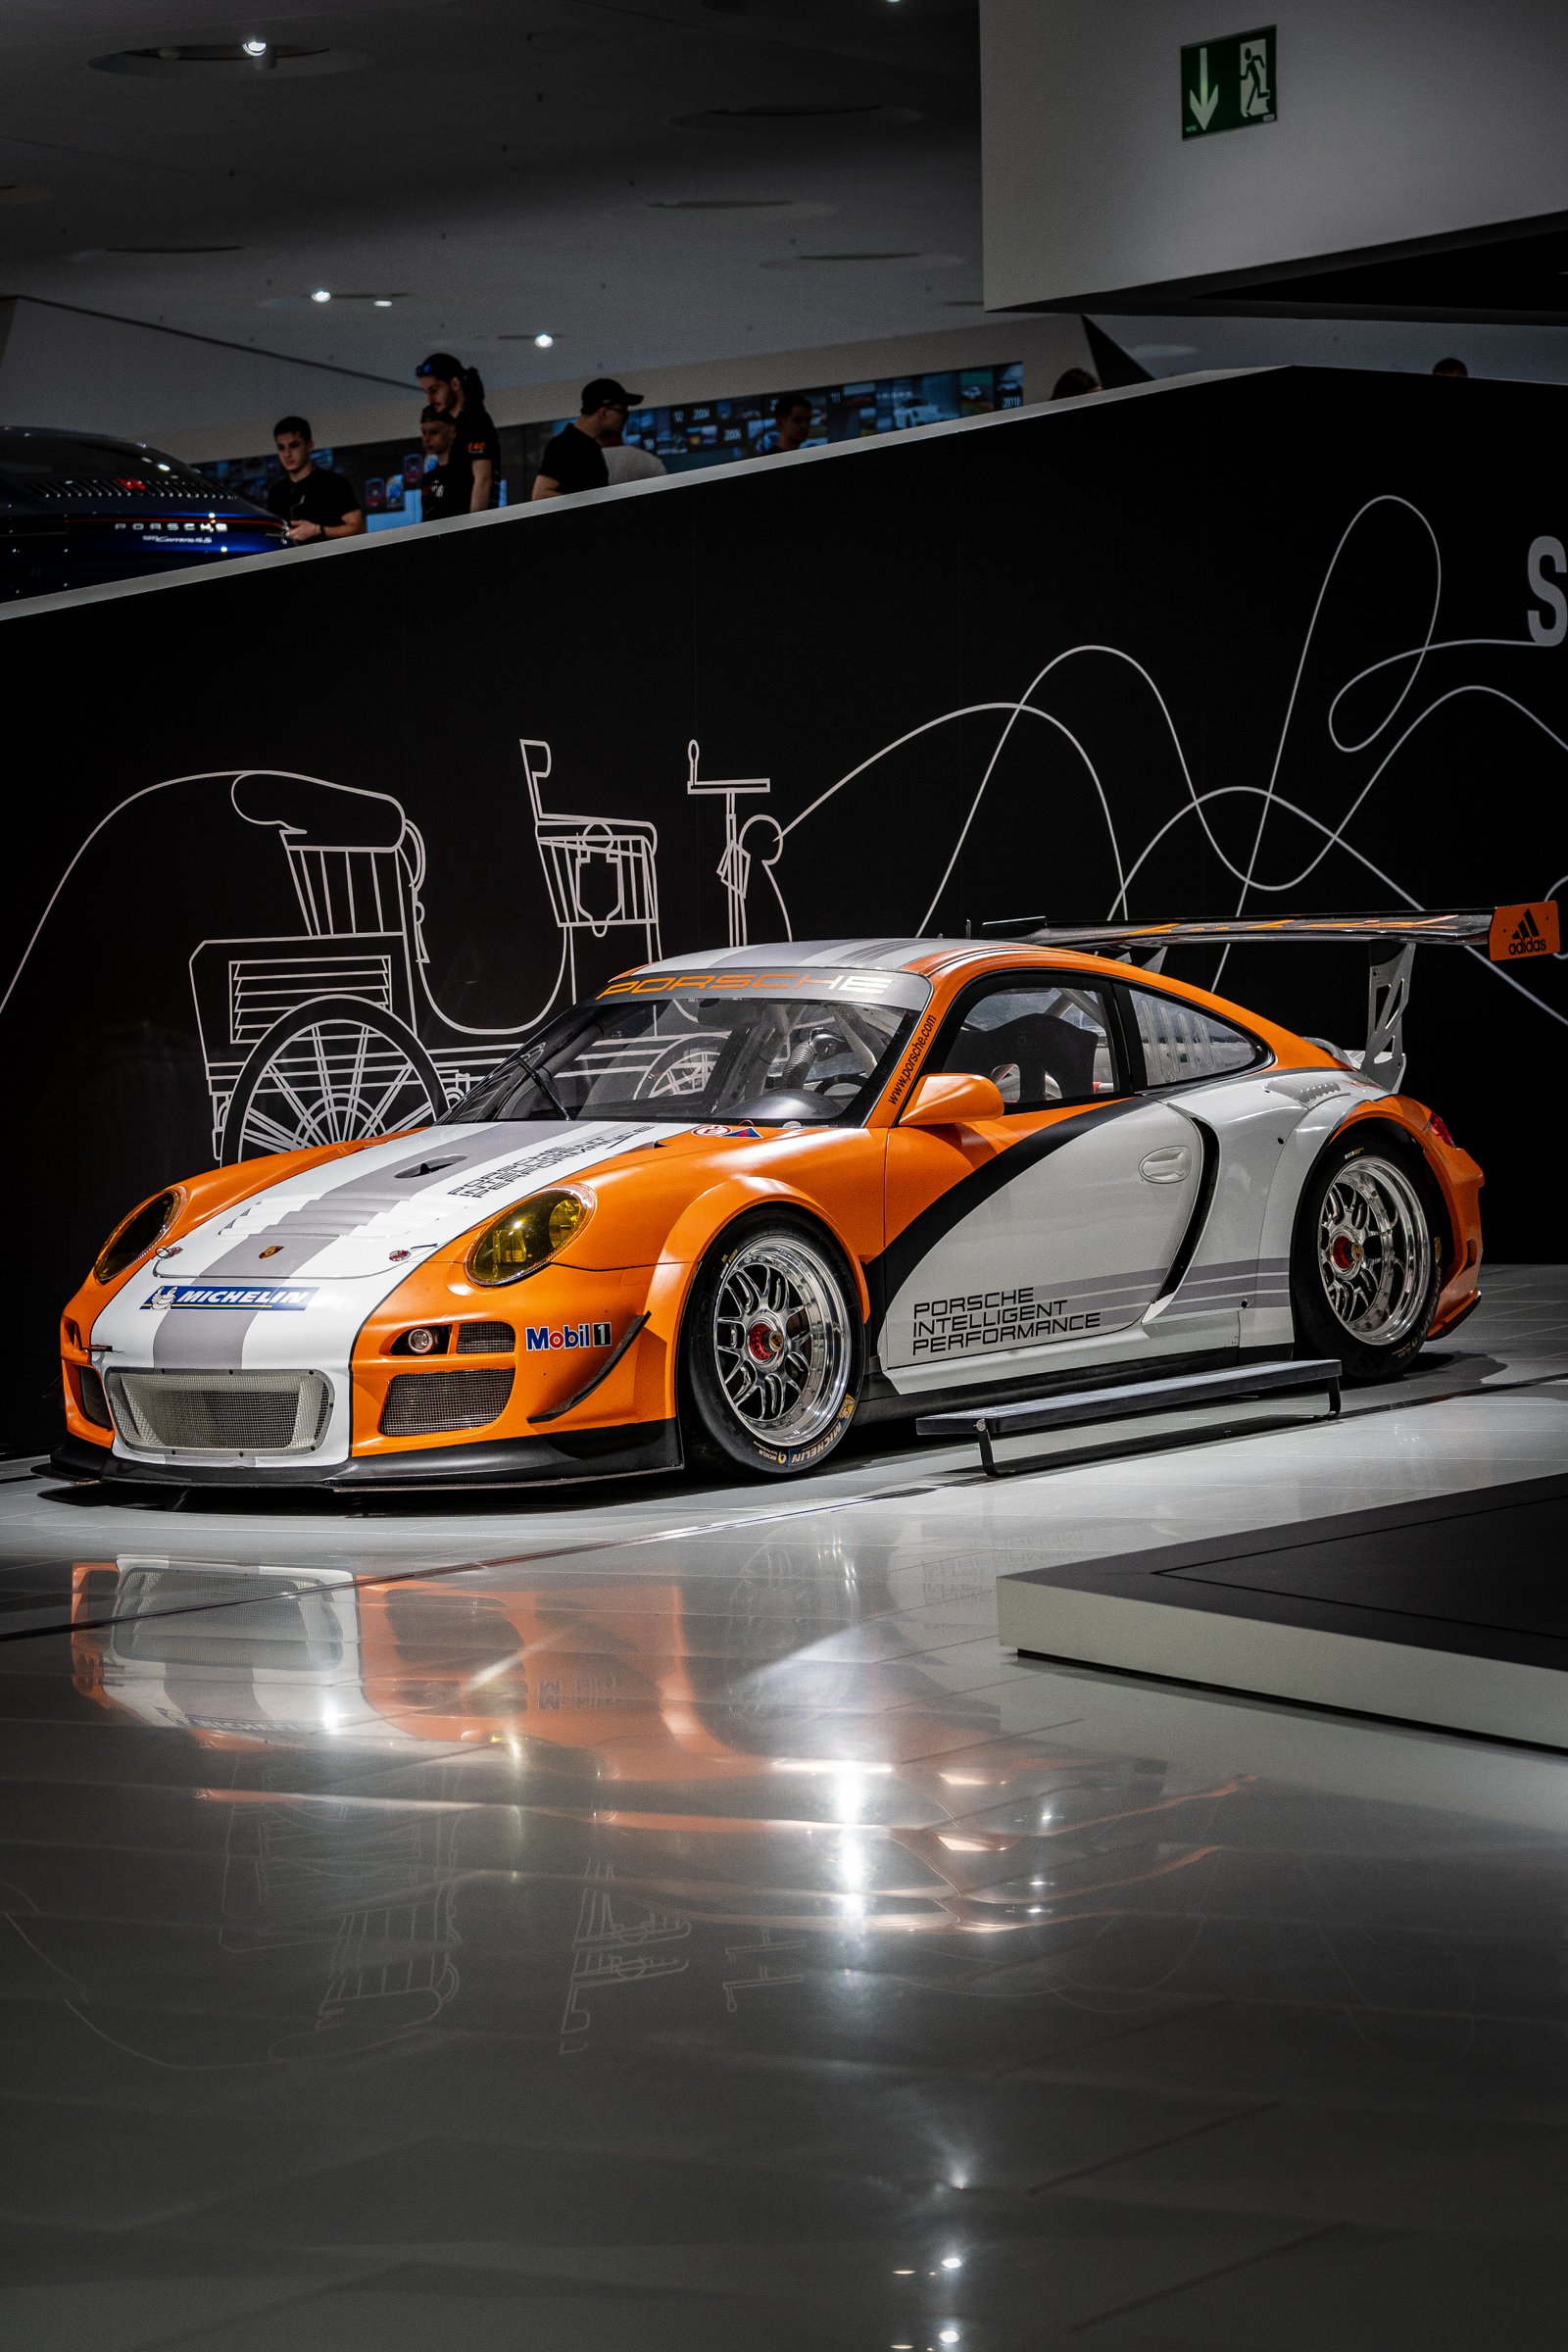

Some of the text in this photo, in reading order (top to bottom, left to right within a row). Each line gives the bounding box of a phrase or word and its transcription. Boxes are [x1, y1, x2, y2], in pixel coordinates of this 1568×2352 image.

[114, 522, 228, 532] PORSCHE
[1527, 535, 1568, 647] S
[1508, 937, 1547, 956] adidas
[595, 973, 894, 1001] PORSCHE
[888, 1014, 937, 1105] www.porsche.com
[447, 1146, 563, 1196] PORSCHE
[177, 1291, 309, 1304] MICHELIN
[913, 1287, 1034, 1319] PORSCHE
[912, 1299, 1068, 1338] INTELLIGENT
[912, 1312, 1102, 1356] PERFORMANCE
[525, 1323, 591, 1351] Mobil
[792, 1422, 842, 1463] MICHELIN
